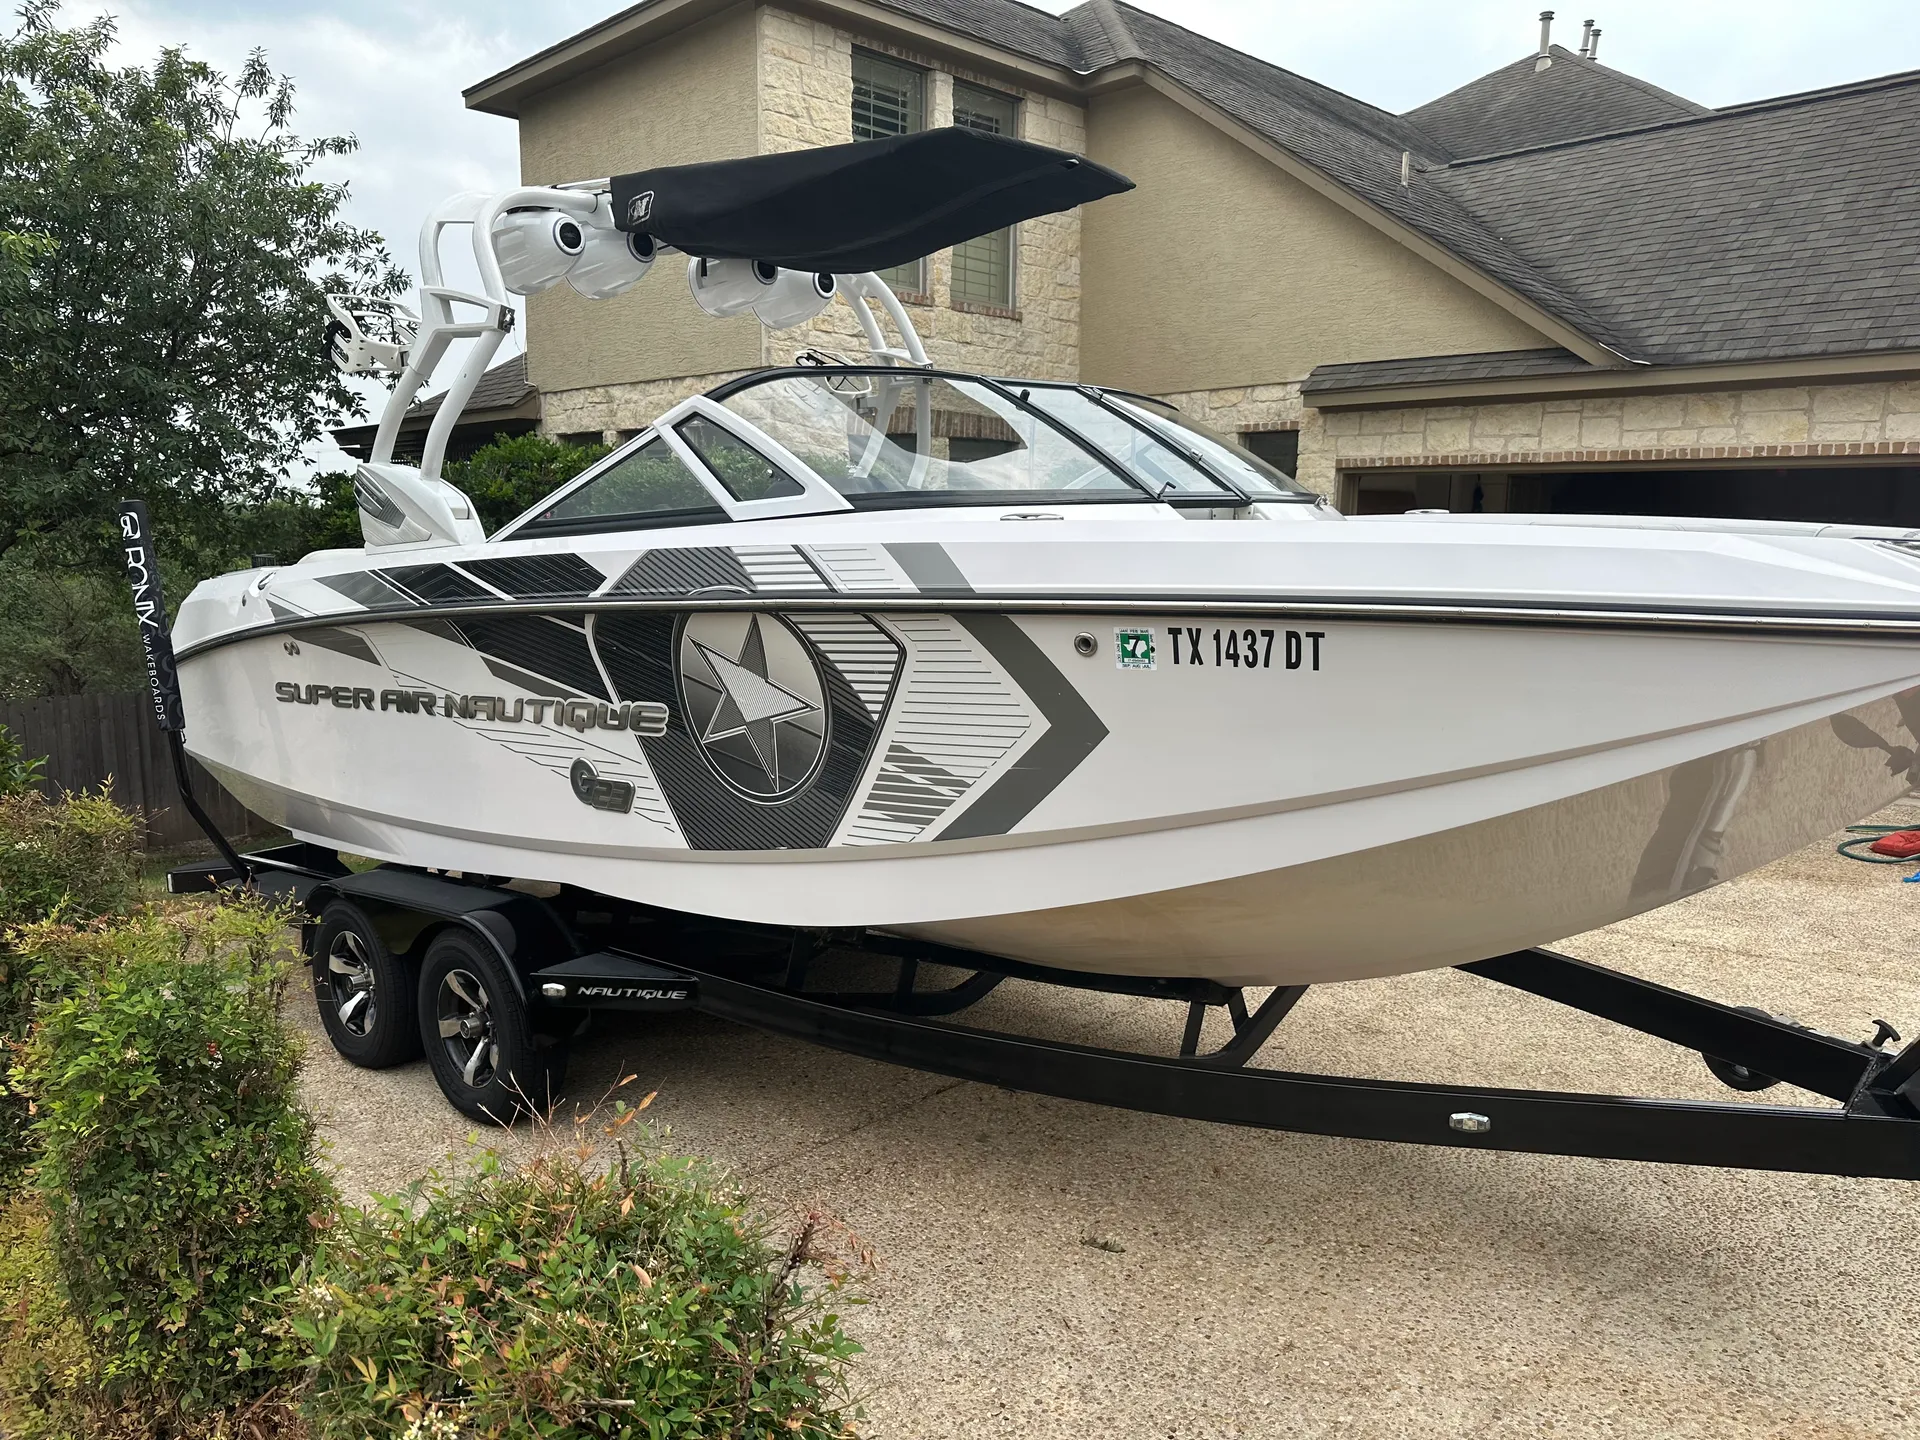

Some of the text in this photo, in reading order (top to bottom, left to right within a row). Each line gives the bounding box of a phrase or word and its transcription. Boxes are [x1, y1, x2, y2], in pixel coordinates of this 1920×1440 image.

[125, 547, 166, 720] RONIX WAKEBOARDS
[1128, 635, 1141, 658] 7
[1168, 627, 1325, 671] TX 1437 DT
[275, 682, 669, 737] SUPER AIR NAUTIQUE
[577, 986, 688, 1000] NAUTIQUE
